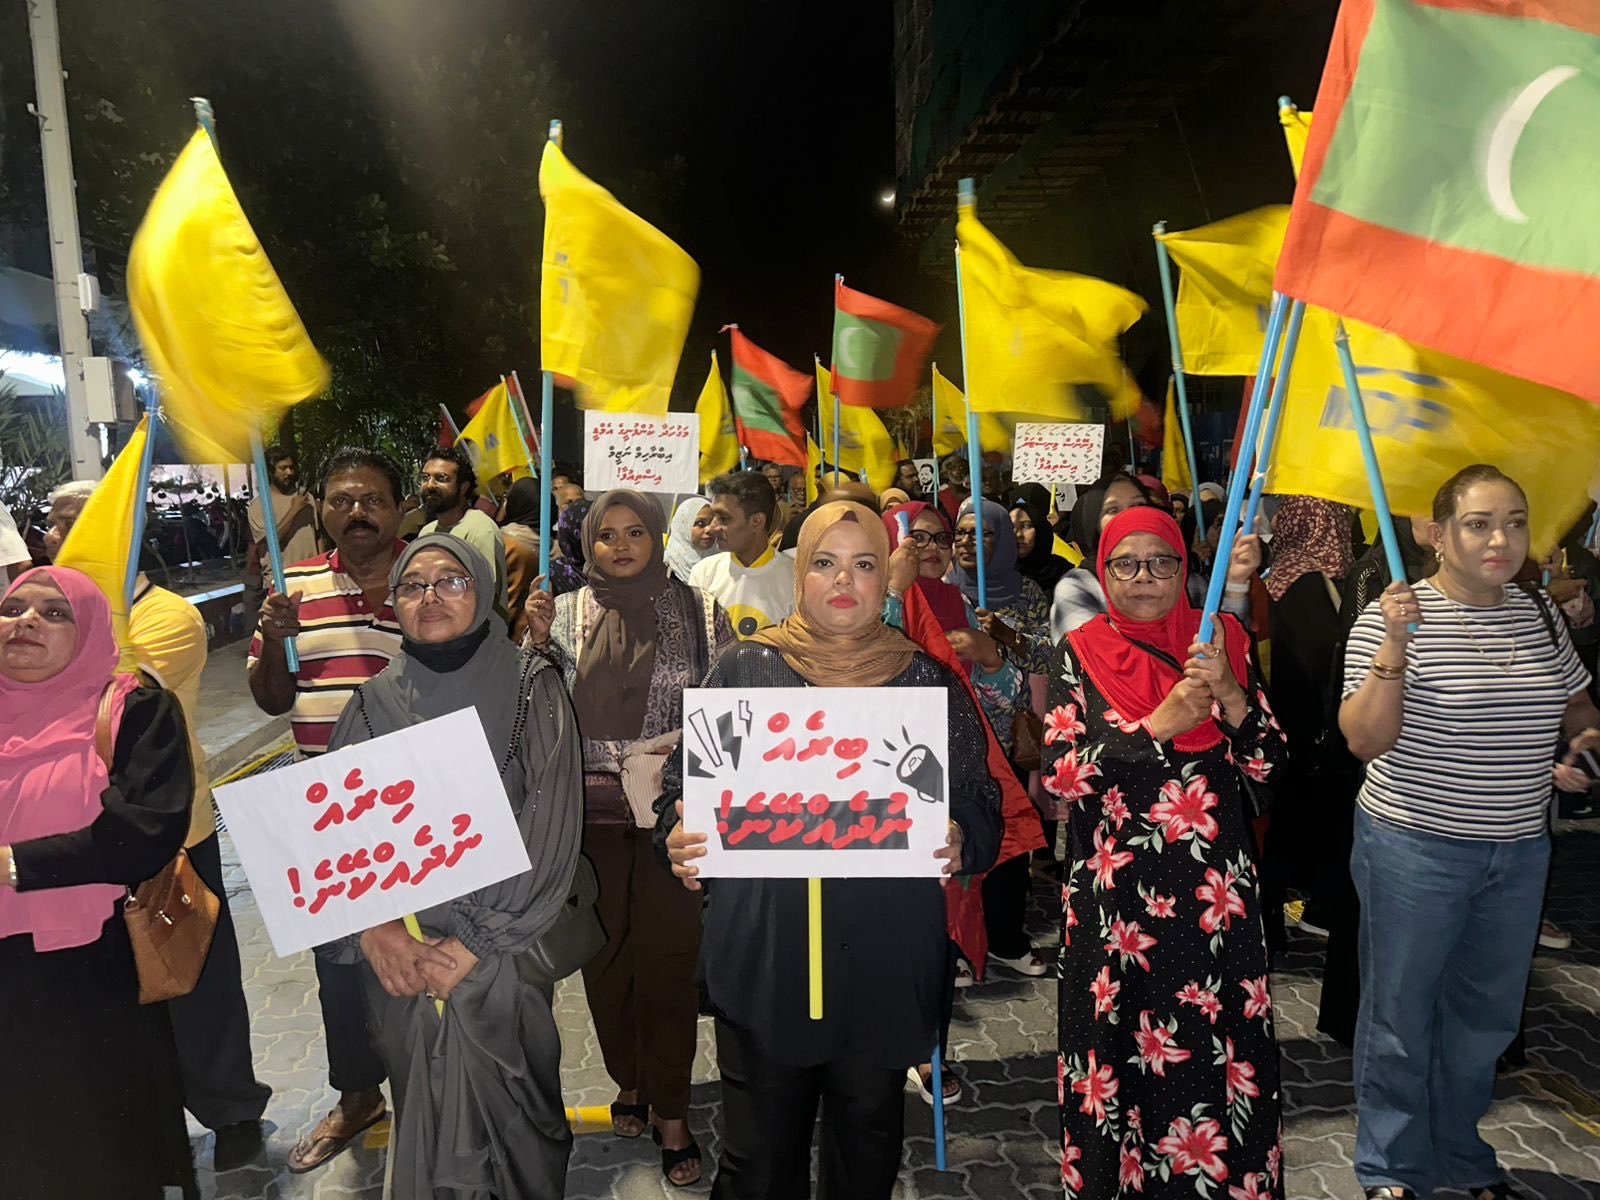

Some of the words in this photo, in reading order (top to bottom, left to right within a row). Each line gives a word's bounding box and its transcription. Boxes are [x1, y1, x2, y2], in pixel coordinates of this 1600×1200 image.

[763, 710, 869, 780] ބިރެއް
[306, 767, 415, 831] ބިރެއް
[716, 789, 913, 851] ނުދެއްކޭނެ!
[287, 813, 483, 914] ނުދެއްކޭނެ!
